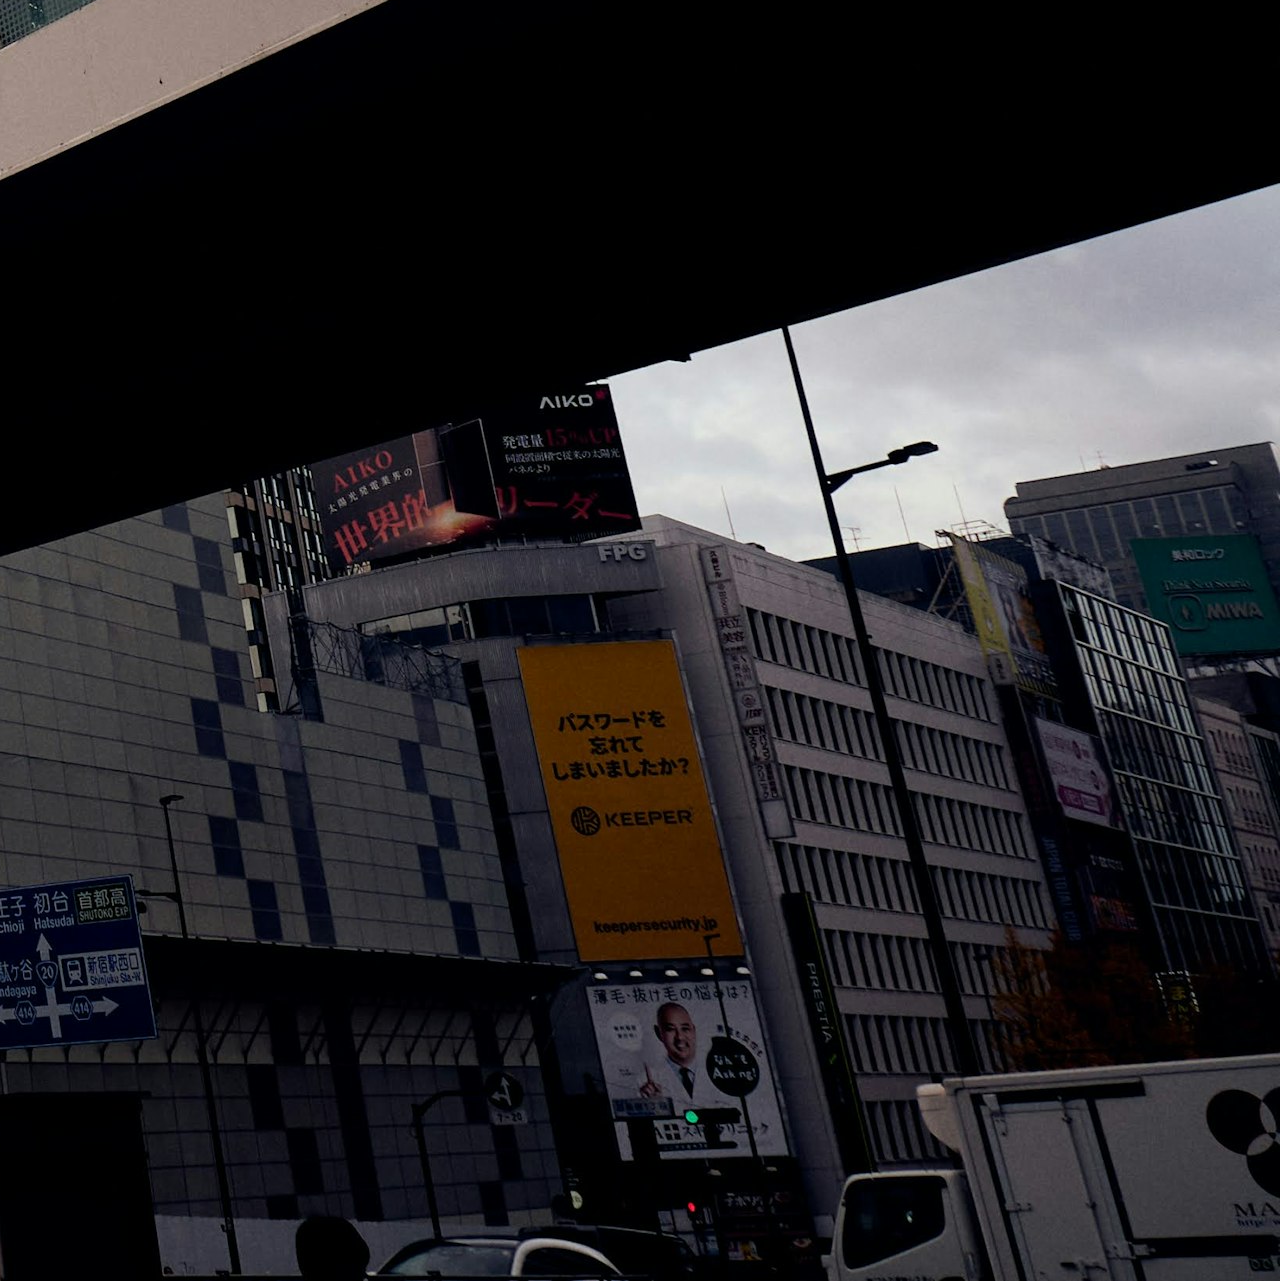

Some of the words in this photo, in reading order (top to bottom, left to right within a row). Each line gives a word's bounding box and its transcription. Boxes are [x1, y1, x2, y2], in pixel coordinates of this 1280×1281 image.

[540, 394, 594, 409] AIKO
[333, 450, 394, 493] AIKO
[496, 483, 635, 522] リーダー
[333, 485, 430, 564] 世界的
[597, 543, 646, 563] FPG
[1206, 601, 1264, 621] MIWA
[558, 710, 666, 732] パスワードを
[588, 736, 644, 755] 忘れて
[551, 757, 689, 781] しまいましたか?
[605, 809, 693, 828] KEEPER
[33, 890, 69, 915] 初台
[76, 887, 127, 911] 首都高
[33, 914, 75, 931] Hatsudai
[79, 907, 114, 922] SHUTOKO
[114, 906, 129, 918] EXP
[594, 915, 718, 935] keepersecurity.jp
[40, 965, 54, 980] 20
[87, 952, 140, 974] 新宿駅西口
[89, 973, 120, 987] Shinjuku
[17, 1006, 32, 1019] 414
[74, 1001, 89, 1015] 414
[805, 961, 834, 1044] PRESTIA
[712, 1066, 758, 1082] Askng!
